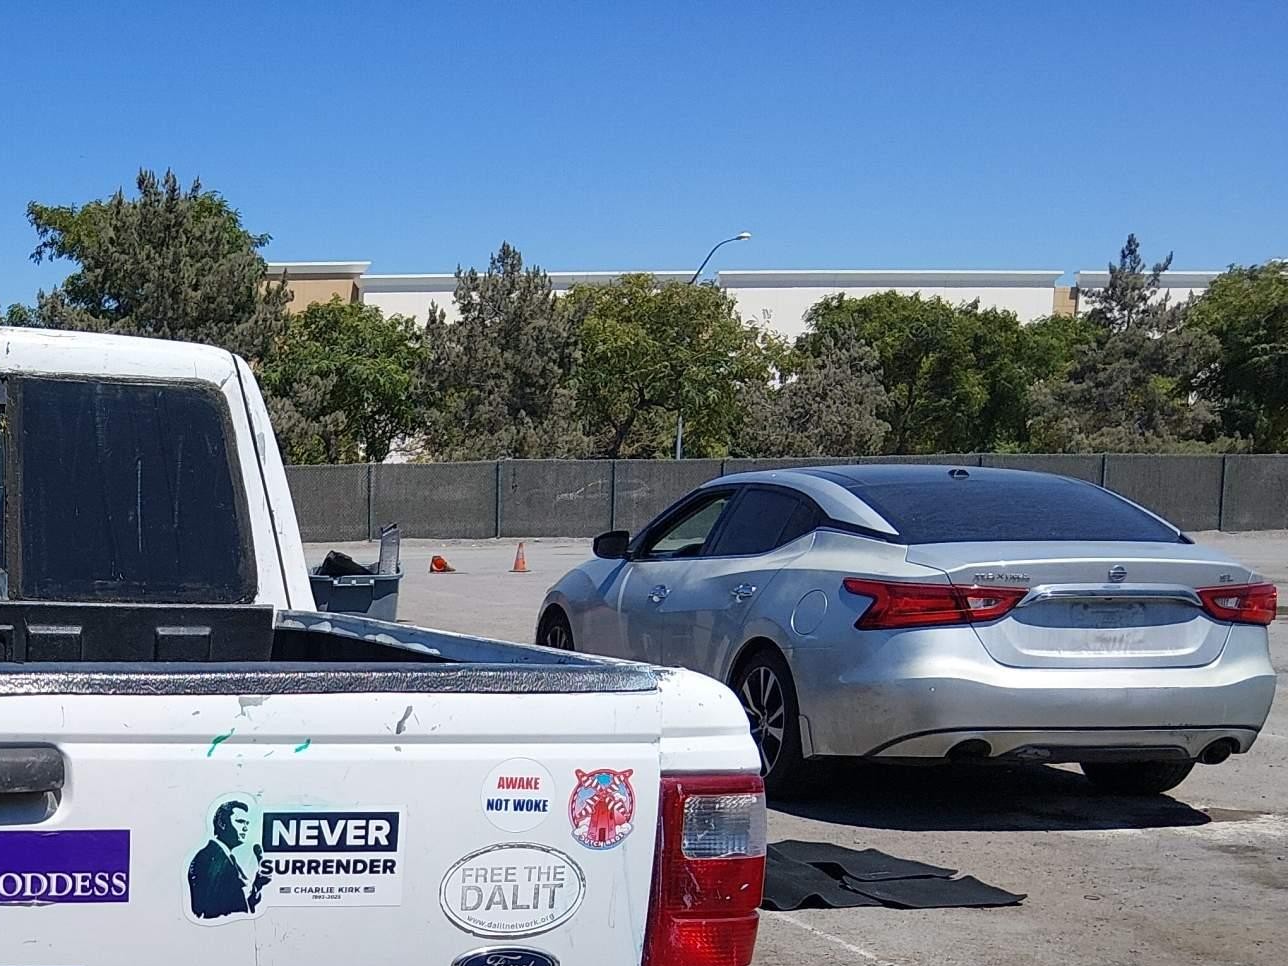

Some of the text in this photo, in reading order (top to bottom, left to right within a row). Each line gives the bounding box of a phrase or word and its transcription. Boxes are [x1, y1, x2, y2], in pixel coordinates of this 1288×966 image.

[497, 776, 541, 790] AWAKE
[486, 798, 549, 812] NOT WOKE
[271, 819, 391, 847] NEVER
[261, 858, 397, 875] SURRENDER
[462, 865, 566, 883] FREE THE
[294, 886, 361, 894] CHARLIE KIRK
[460, 883, 564, 912] DALIT
[466, 912, 555, 930] www.dalitnetwork.org
